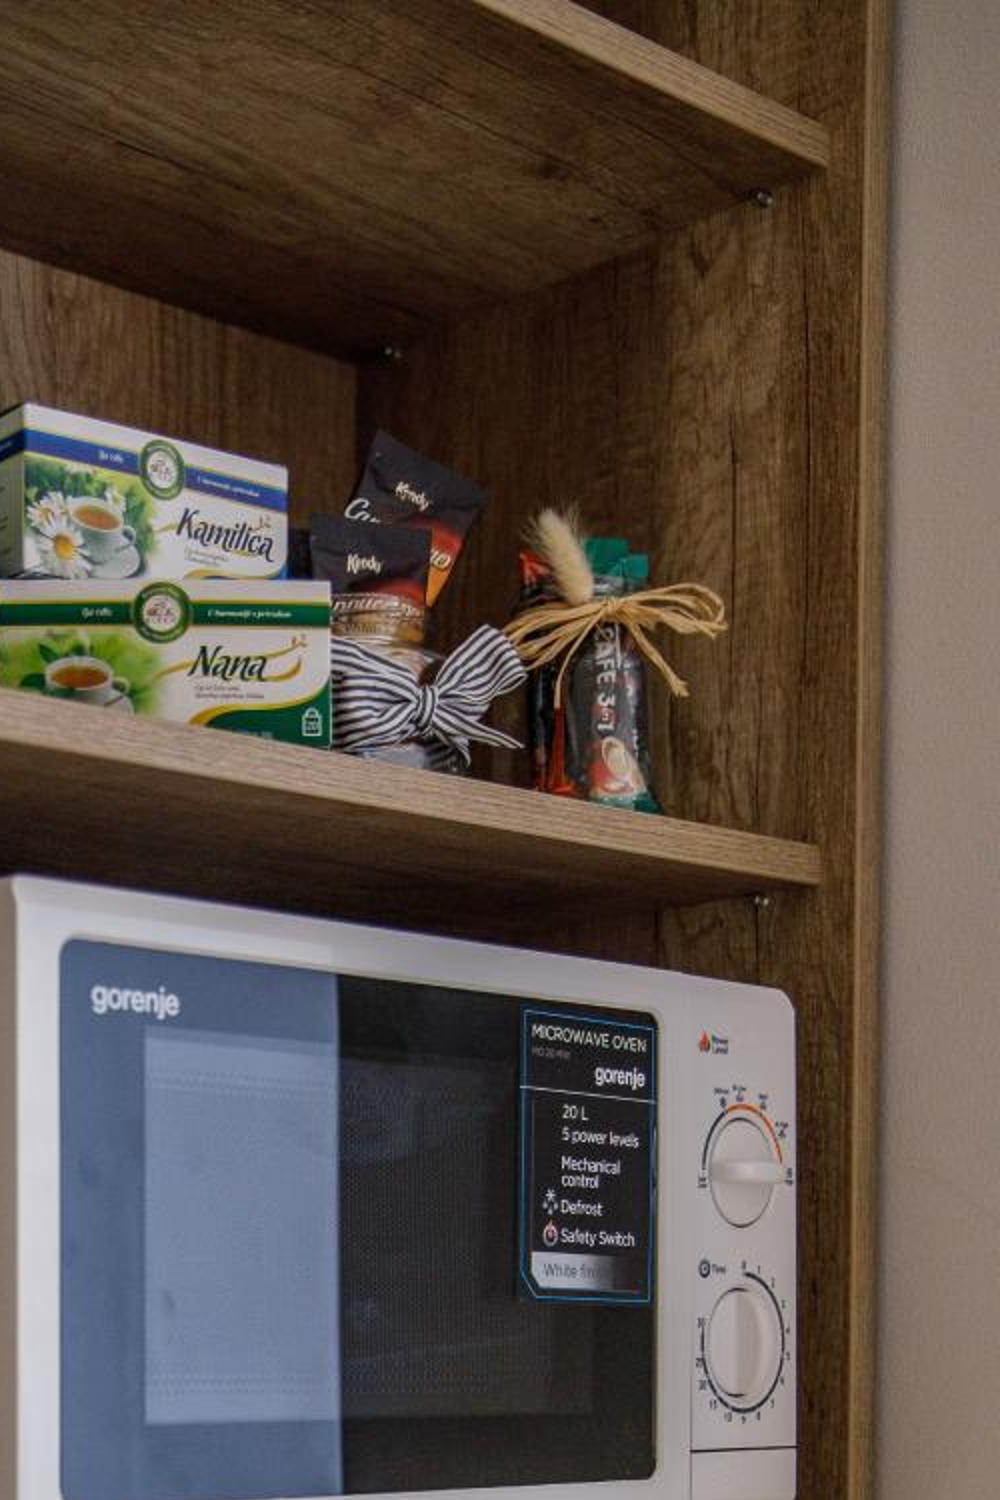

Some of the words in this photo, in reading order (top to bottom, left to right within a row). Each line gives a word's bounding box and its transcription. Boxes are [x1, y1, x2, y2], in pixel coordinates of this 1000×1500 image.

[176, 507, 275, 562] Kamilica
[187, 645, 268, 682] Nana
[91, 985, 180, 1020] gorenje
[531, 1024, 611, 1049] MICROWAVE
[612, 1035, 647, 1053] OVEN
[594, 1067, 645, 1091] gorenje
[562, 1104, 579, 1119] 20
[581, 1106, 589, 1121] L
[561, 1126, 570, 1141] 5
[571, 1130, 607, 1145] power
[609, 1131, 639, 1149] levels
[561, 1156, 621, 1175] Mechanical
[561, 1174, 600, 1189] control
[560, 1199, 603, 1217] Defrost
[560, 1228, 597, 1248] Safety
[599, 1232, 636, 1247] Switch
[543, 1263, 577, 1279] White
